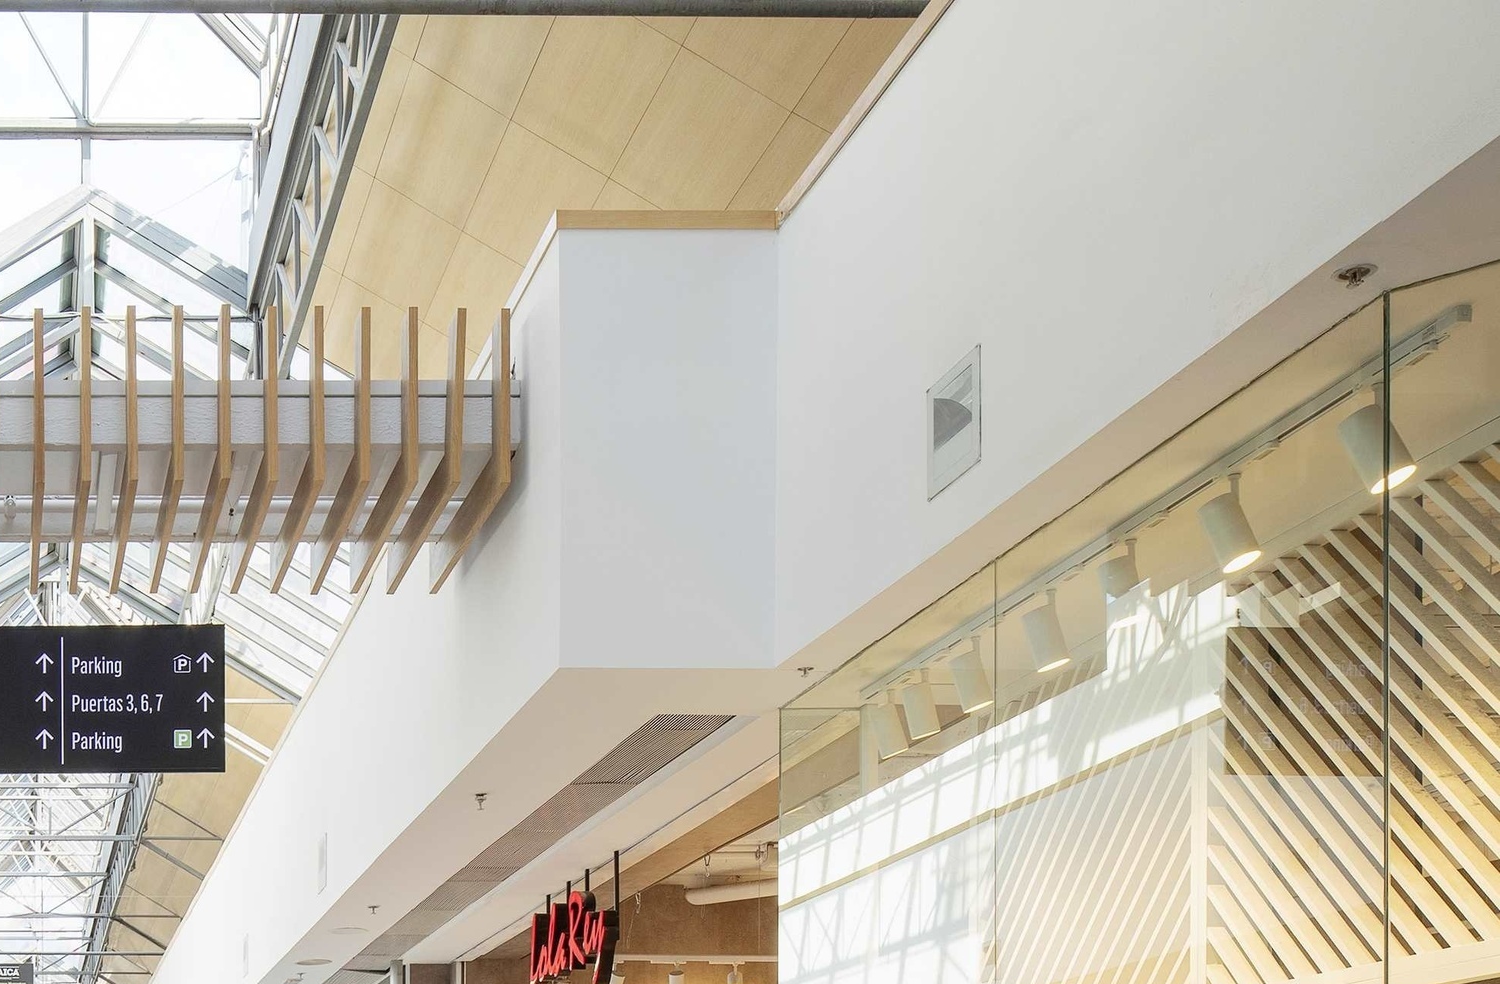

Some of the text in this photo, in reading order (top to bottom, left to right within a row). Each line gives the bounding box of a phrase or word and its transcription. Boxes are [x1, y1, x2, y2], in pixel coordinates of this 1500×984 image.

[71, 655, 122, 678] Parking
[71, 693, 164, 715] Puertas 3, 6, 7
[71, 731, 123, 754] Parking
